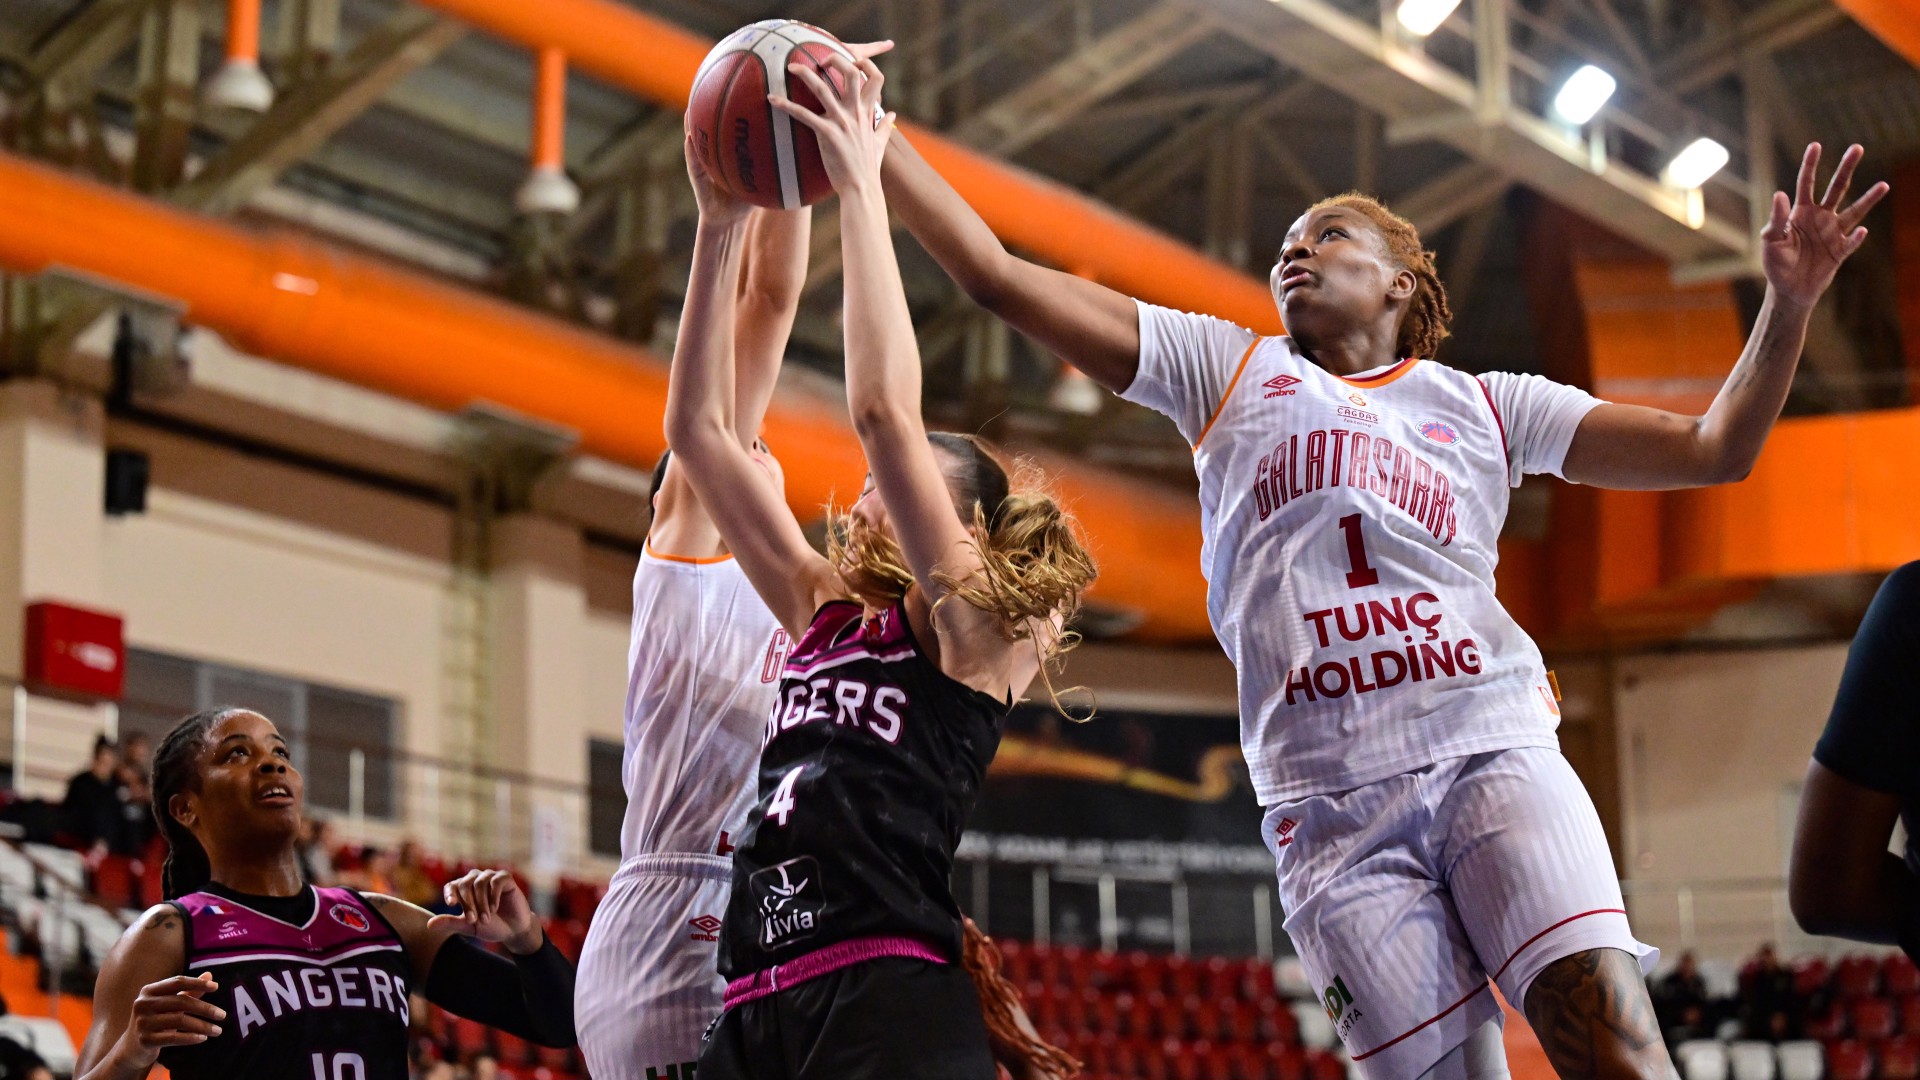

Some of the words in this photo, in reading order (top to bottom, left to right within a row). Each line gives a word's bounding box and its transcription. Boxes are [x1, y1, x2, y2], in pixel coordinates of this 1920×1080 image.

[1264, 389, 1296, 399] umbro
[1339, 513, 1379, 589] 1
[1304, 592, 1442, 648] TUNÇ
[760, 678, 907, 752] NGERS
[767, 766, 804, 826] 4
[218, 928, 249, 940] SKILLS
[691, 932, 719, 942] umbr
[233, 966, 410, 1039] ANGERS
